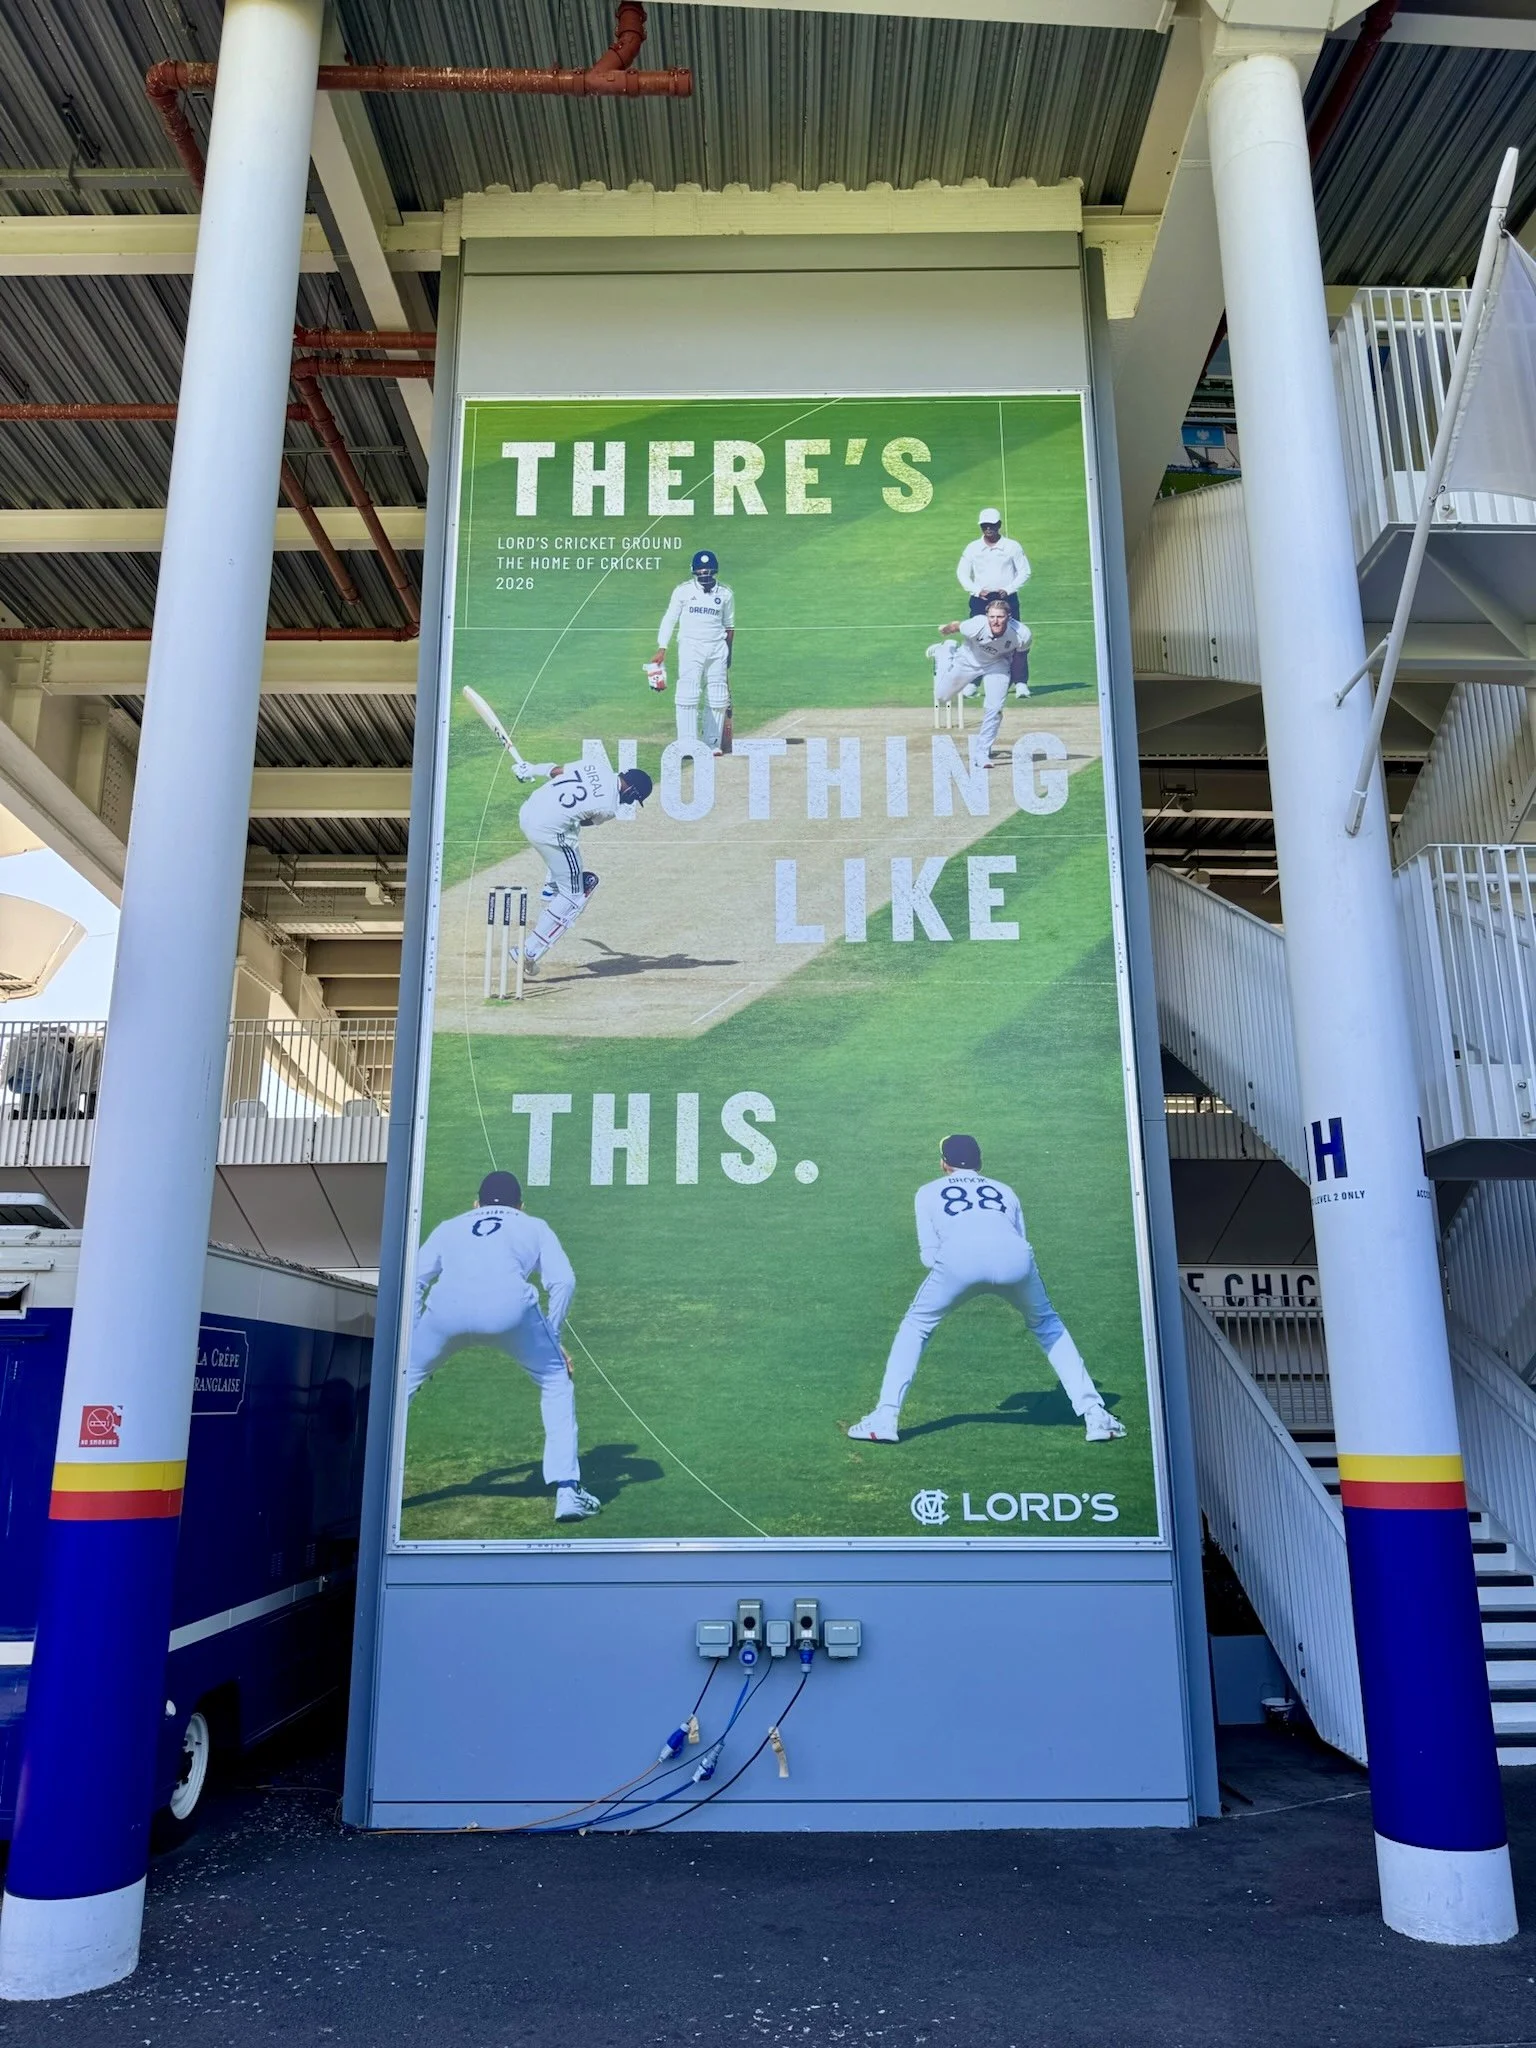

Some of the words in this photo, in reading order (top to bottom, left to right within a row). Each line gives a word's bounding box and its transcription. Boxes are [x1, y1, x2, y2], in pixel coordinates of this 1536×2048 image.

[502, 437, 933, 516] THERE'S
[498, 537, 549, 550] LORD'S
[554, 537, 616, 550] CRICKET
[622, 537, 682, 550] GROUND
[497, 557, 525, 570] THE
[530, 557, 571, 570] HOME
[576, 557, 595, 570] OF
[600, 557, 662, 570] CRICKET
[496, 577, 534, 590] 2026
[552, 770, 587, 809] 73
[581, 732, 1069, 821] NOTHING
[584, 765, 605, 798] SIRAJ
[775, 855, 1020, 944] LIKE
[511, 1091, 819, 1186] THIS.
[941, 1185, 1007, 1216] 88
[1333, 1192, 1339, 1201] 2
[1342, 1190, 1365, 1200] ONLY
[962, 1492, 1120, 1522] LORD'S
